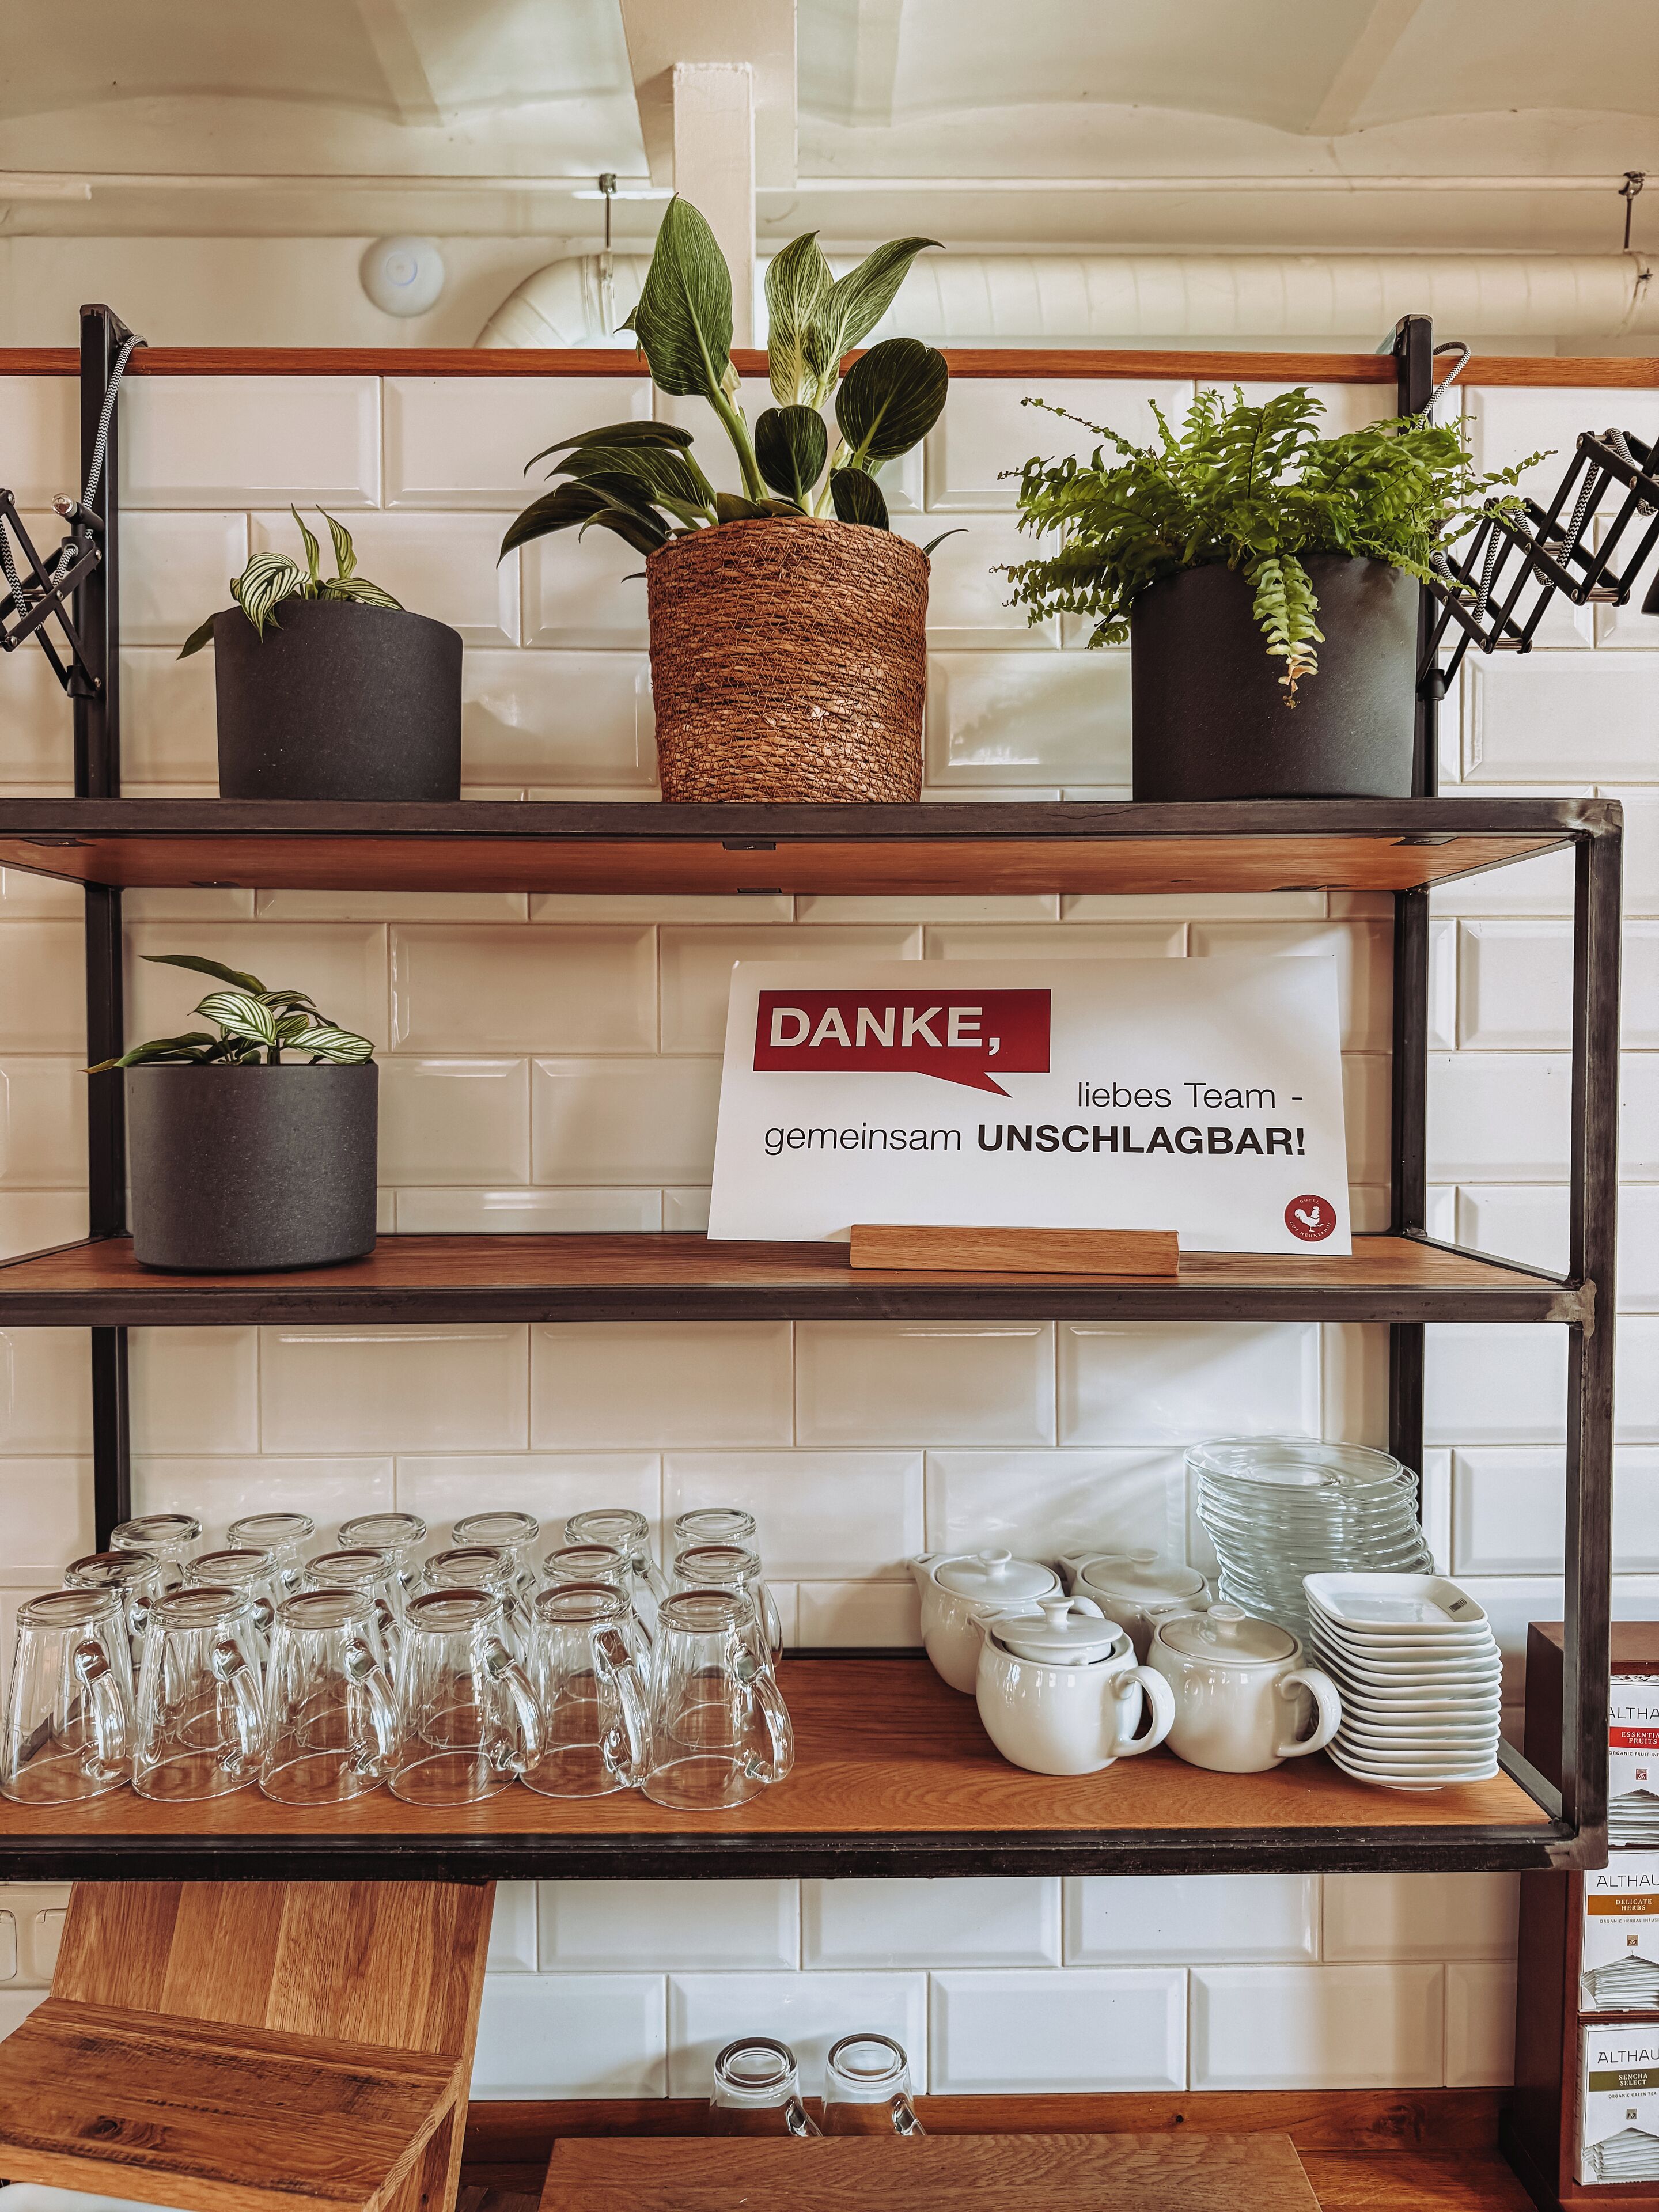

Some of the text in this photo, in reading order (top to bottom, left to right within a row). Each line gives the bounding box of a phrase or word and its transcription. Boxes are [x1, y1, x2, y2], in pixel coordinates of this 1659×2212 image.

[770, 1007, 1001, 1056] DANKE,
[1078, 1082, 1171, 1108] liebes
[1183, 1082, 1276, 1108] Team
[764, 1122, 1306, 1156] gemeinsam UNSCHLAGBAR!
[1597, 2049, 1659, 2063] ALTHAU
